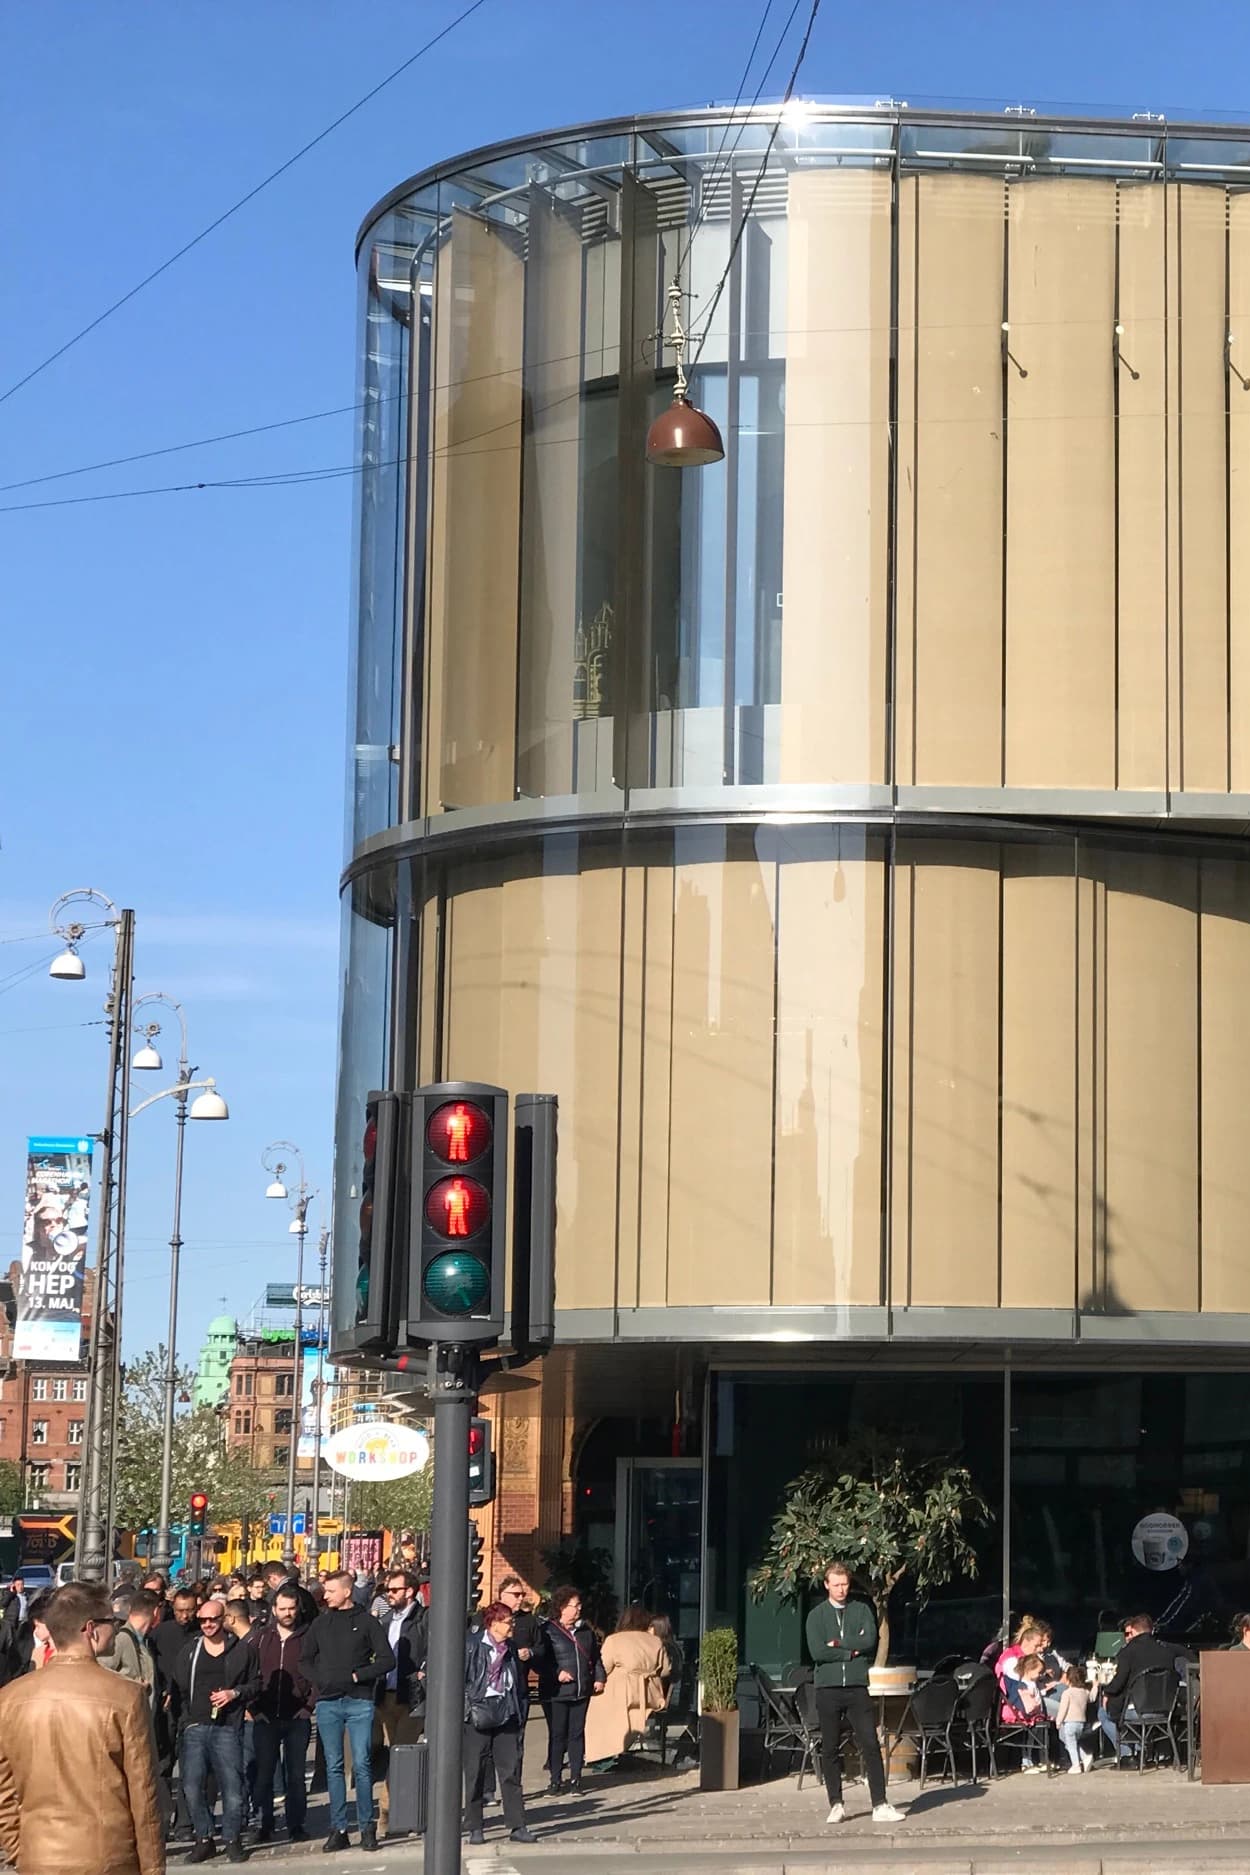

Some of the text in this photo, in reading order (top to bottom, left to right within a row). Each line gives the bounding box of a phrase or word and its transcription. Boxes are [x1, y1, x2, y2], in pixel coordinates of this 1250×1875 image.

[58, 1261, 76, 1272] OG
[28, 1274, 75, 1295] HEP
[29, 1296, 74, 1310] 13. MAJ
[336, 1451, 417, 1465] WORKSHOP
